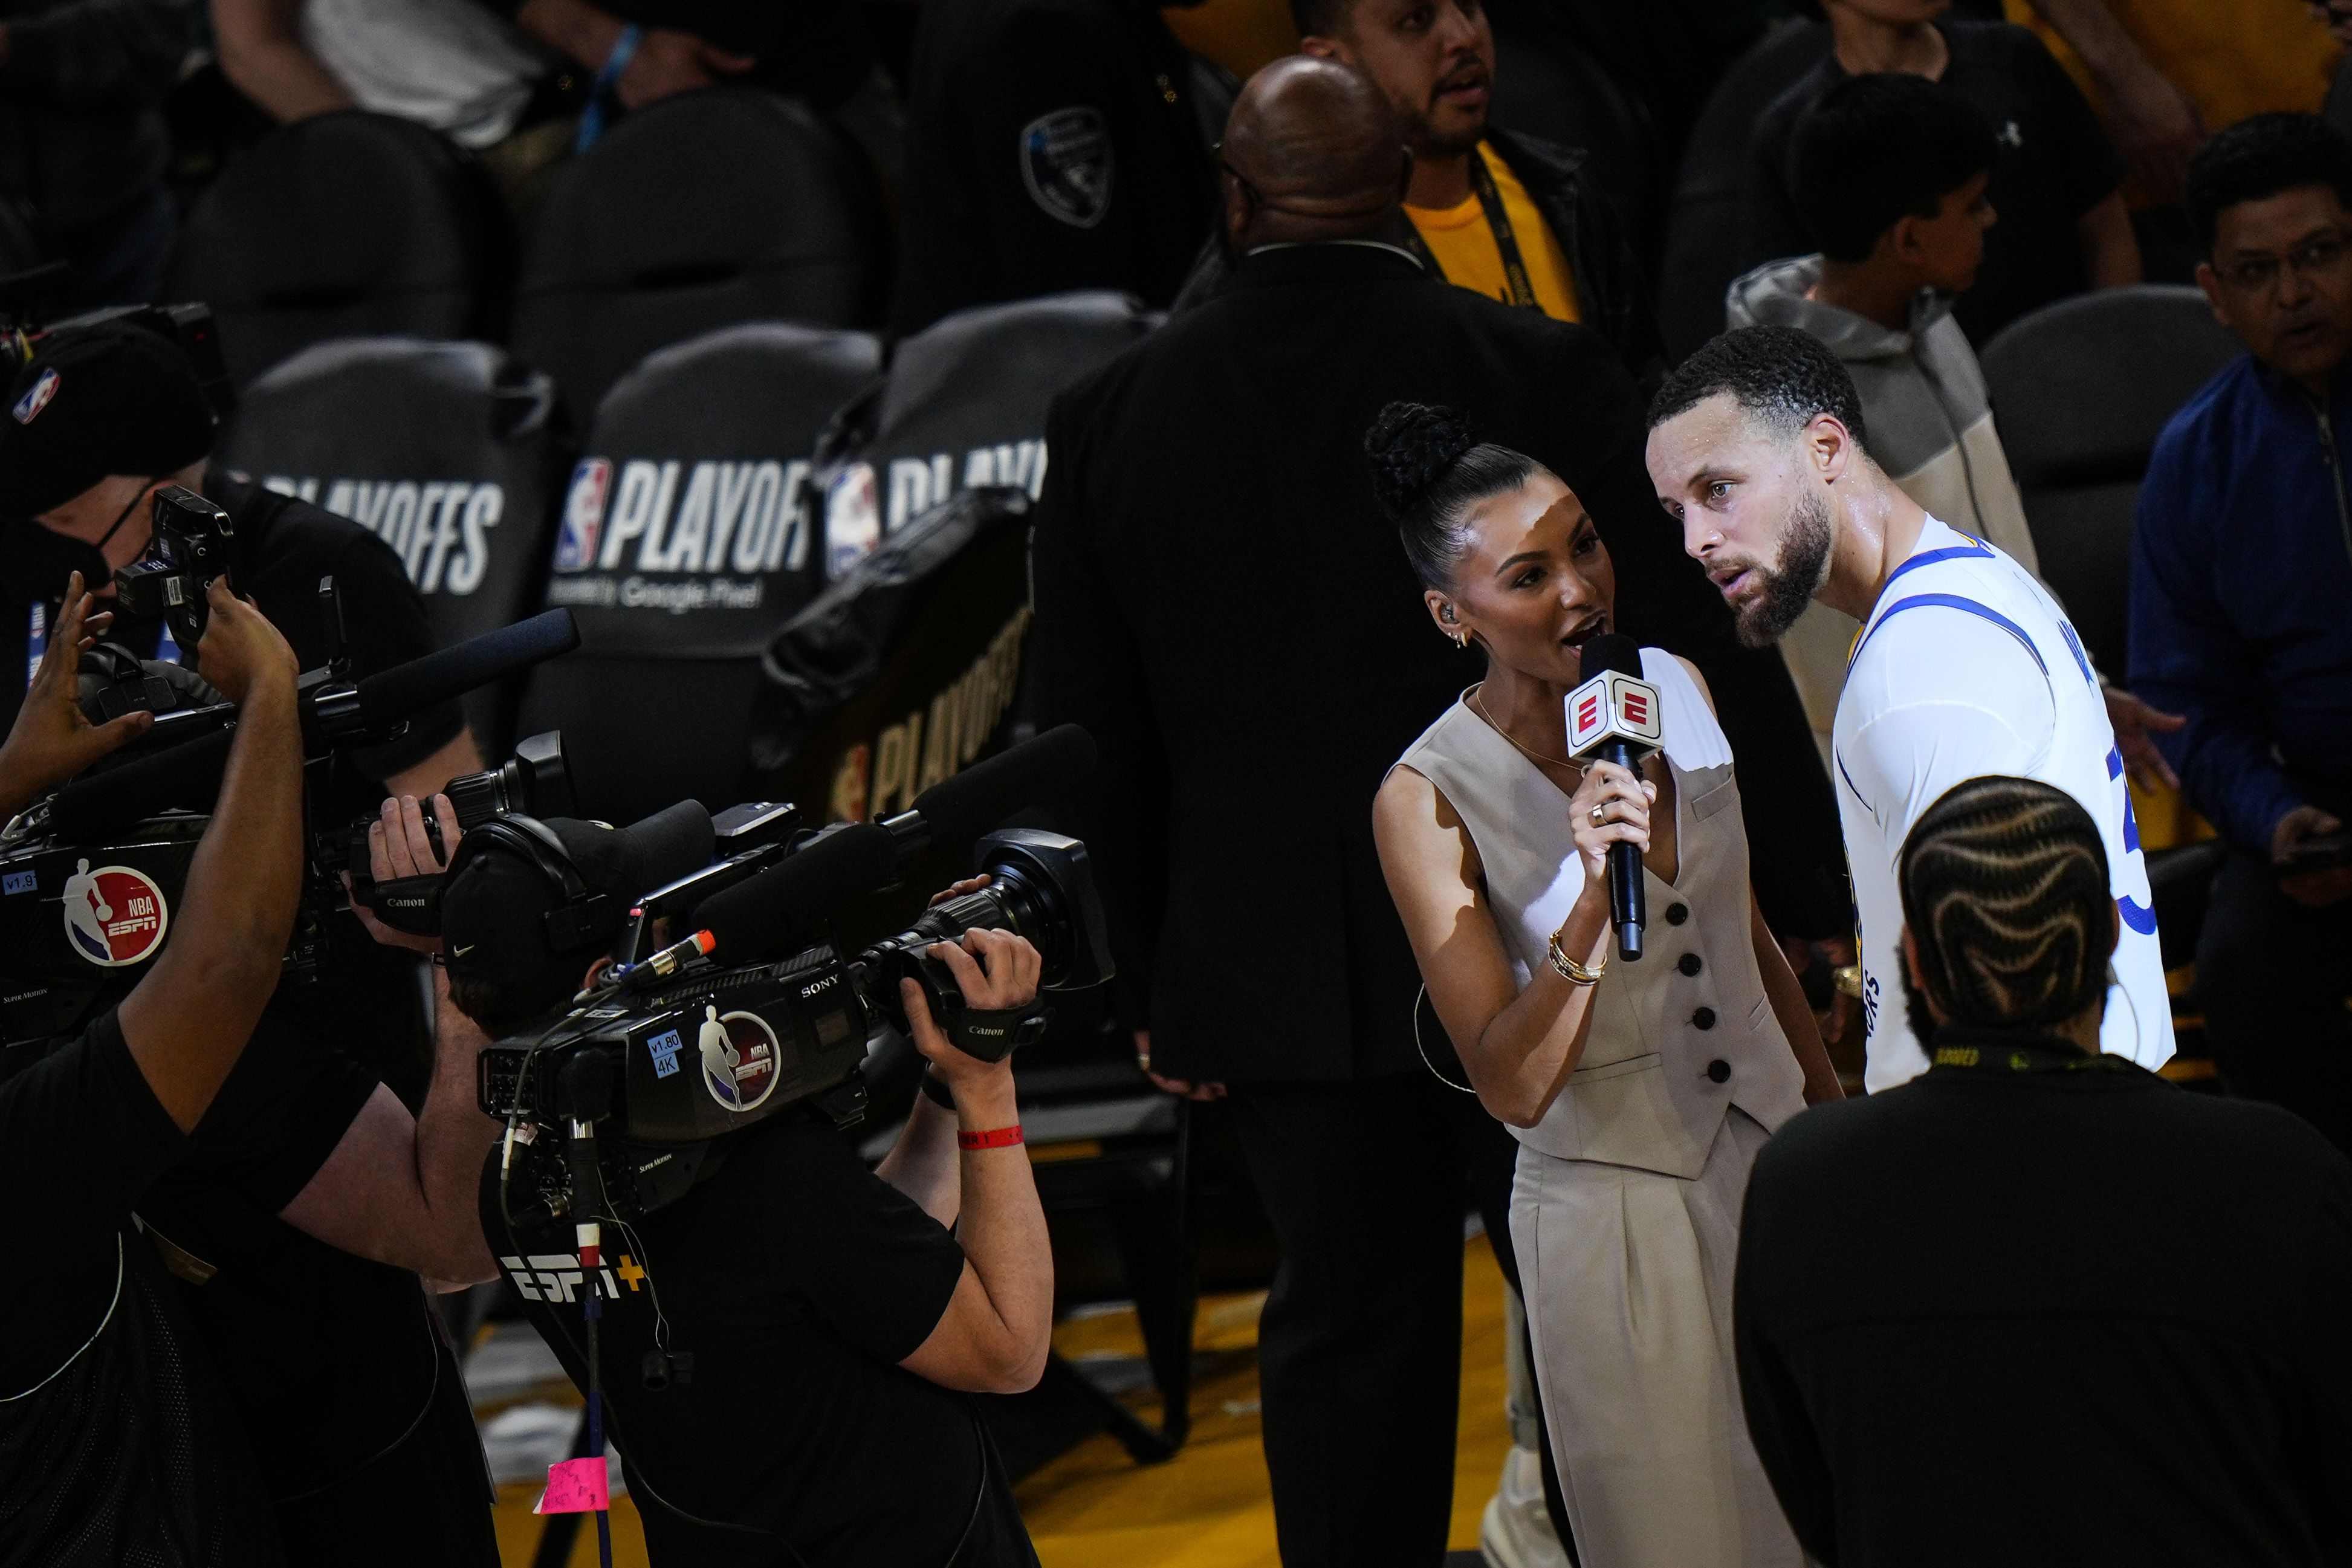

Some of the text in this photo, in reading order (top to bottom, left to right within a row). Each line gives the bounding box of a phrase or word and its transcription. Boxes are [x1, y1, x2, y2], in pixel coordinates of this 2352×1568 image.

[7, 874, 37, 890] v1.9
[128, 896, 155, 918] NBA
[386, 898, 426, 907] Canon
[108, 916, 157, 938] ESPN
[22, 988, 48, 1000] MOTION
[801, 974, 840, 999] SONY
[968, 1025, 1005, 1036] Canon
[651, 1034, 679, 1054] v1.80
[750, 1043, 770, 1060] NBA
[658, 1059, 677, 1074] 4K
[736, 1058, 773, 1082] ESPN
